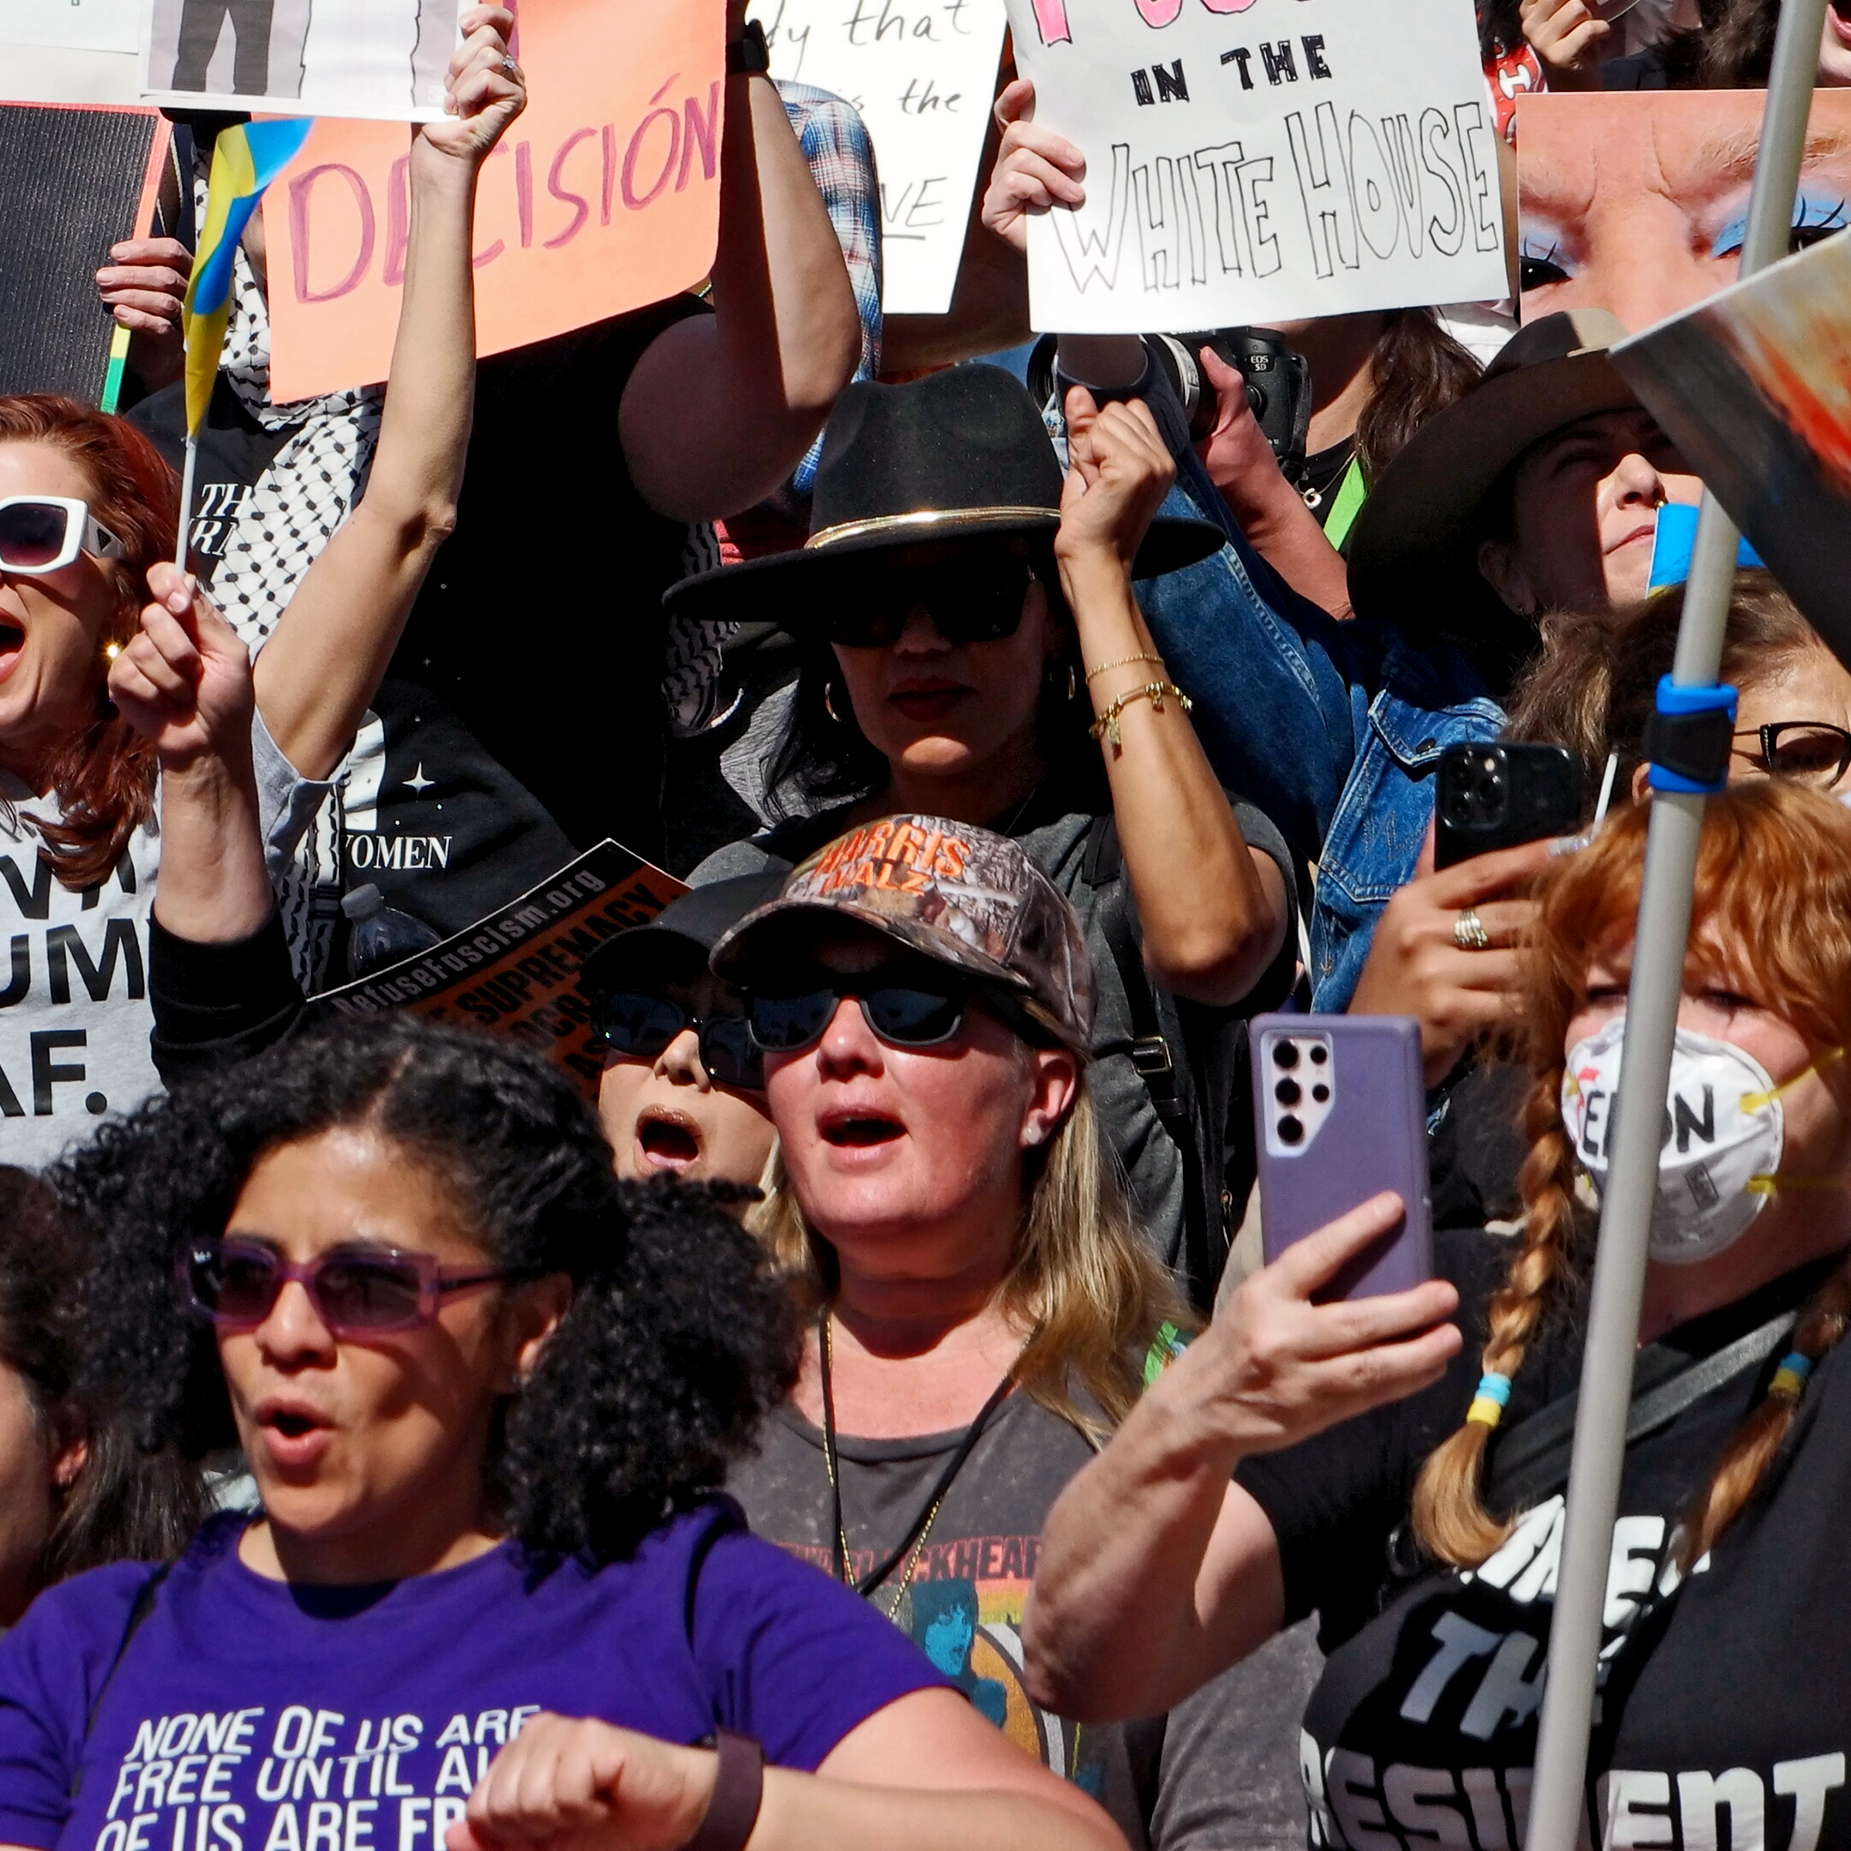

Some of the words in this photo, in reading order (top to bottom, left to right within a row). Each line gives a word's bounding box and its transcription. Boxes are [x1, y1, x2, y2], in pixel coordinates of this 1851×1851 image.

[898, 80, 961, 115] the
[1131, 58, 1187, 107] IN
[1221, 33, 1333, 91] THE
[1049, 143, 1281, 297] WHITE
[1286, 101, 1498, 279] HOUSE
[1251, 356, 1268, 364] EOS
[343, 835, 453, 870] OMEN
[812, 822, 970, 878] HARRIS
[820, 862, 931, 896] WALZ
[127, 1708, 264, 1762] NONE
[273, 1704, 343, 1759] OF
[357, 1718, 423, 1757] US
[450, 1705, 542, 1750] ARE
[106, 1760, 238, 1818] FREE
[256, 1752, 411, 1806] UNTIL
